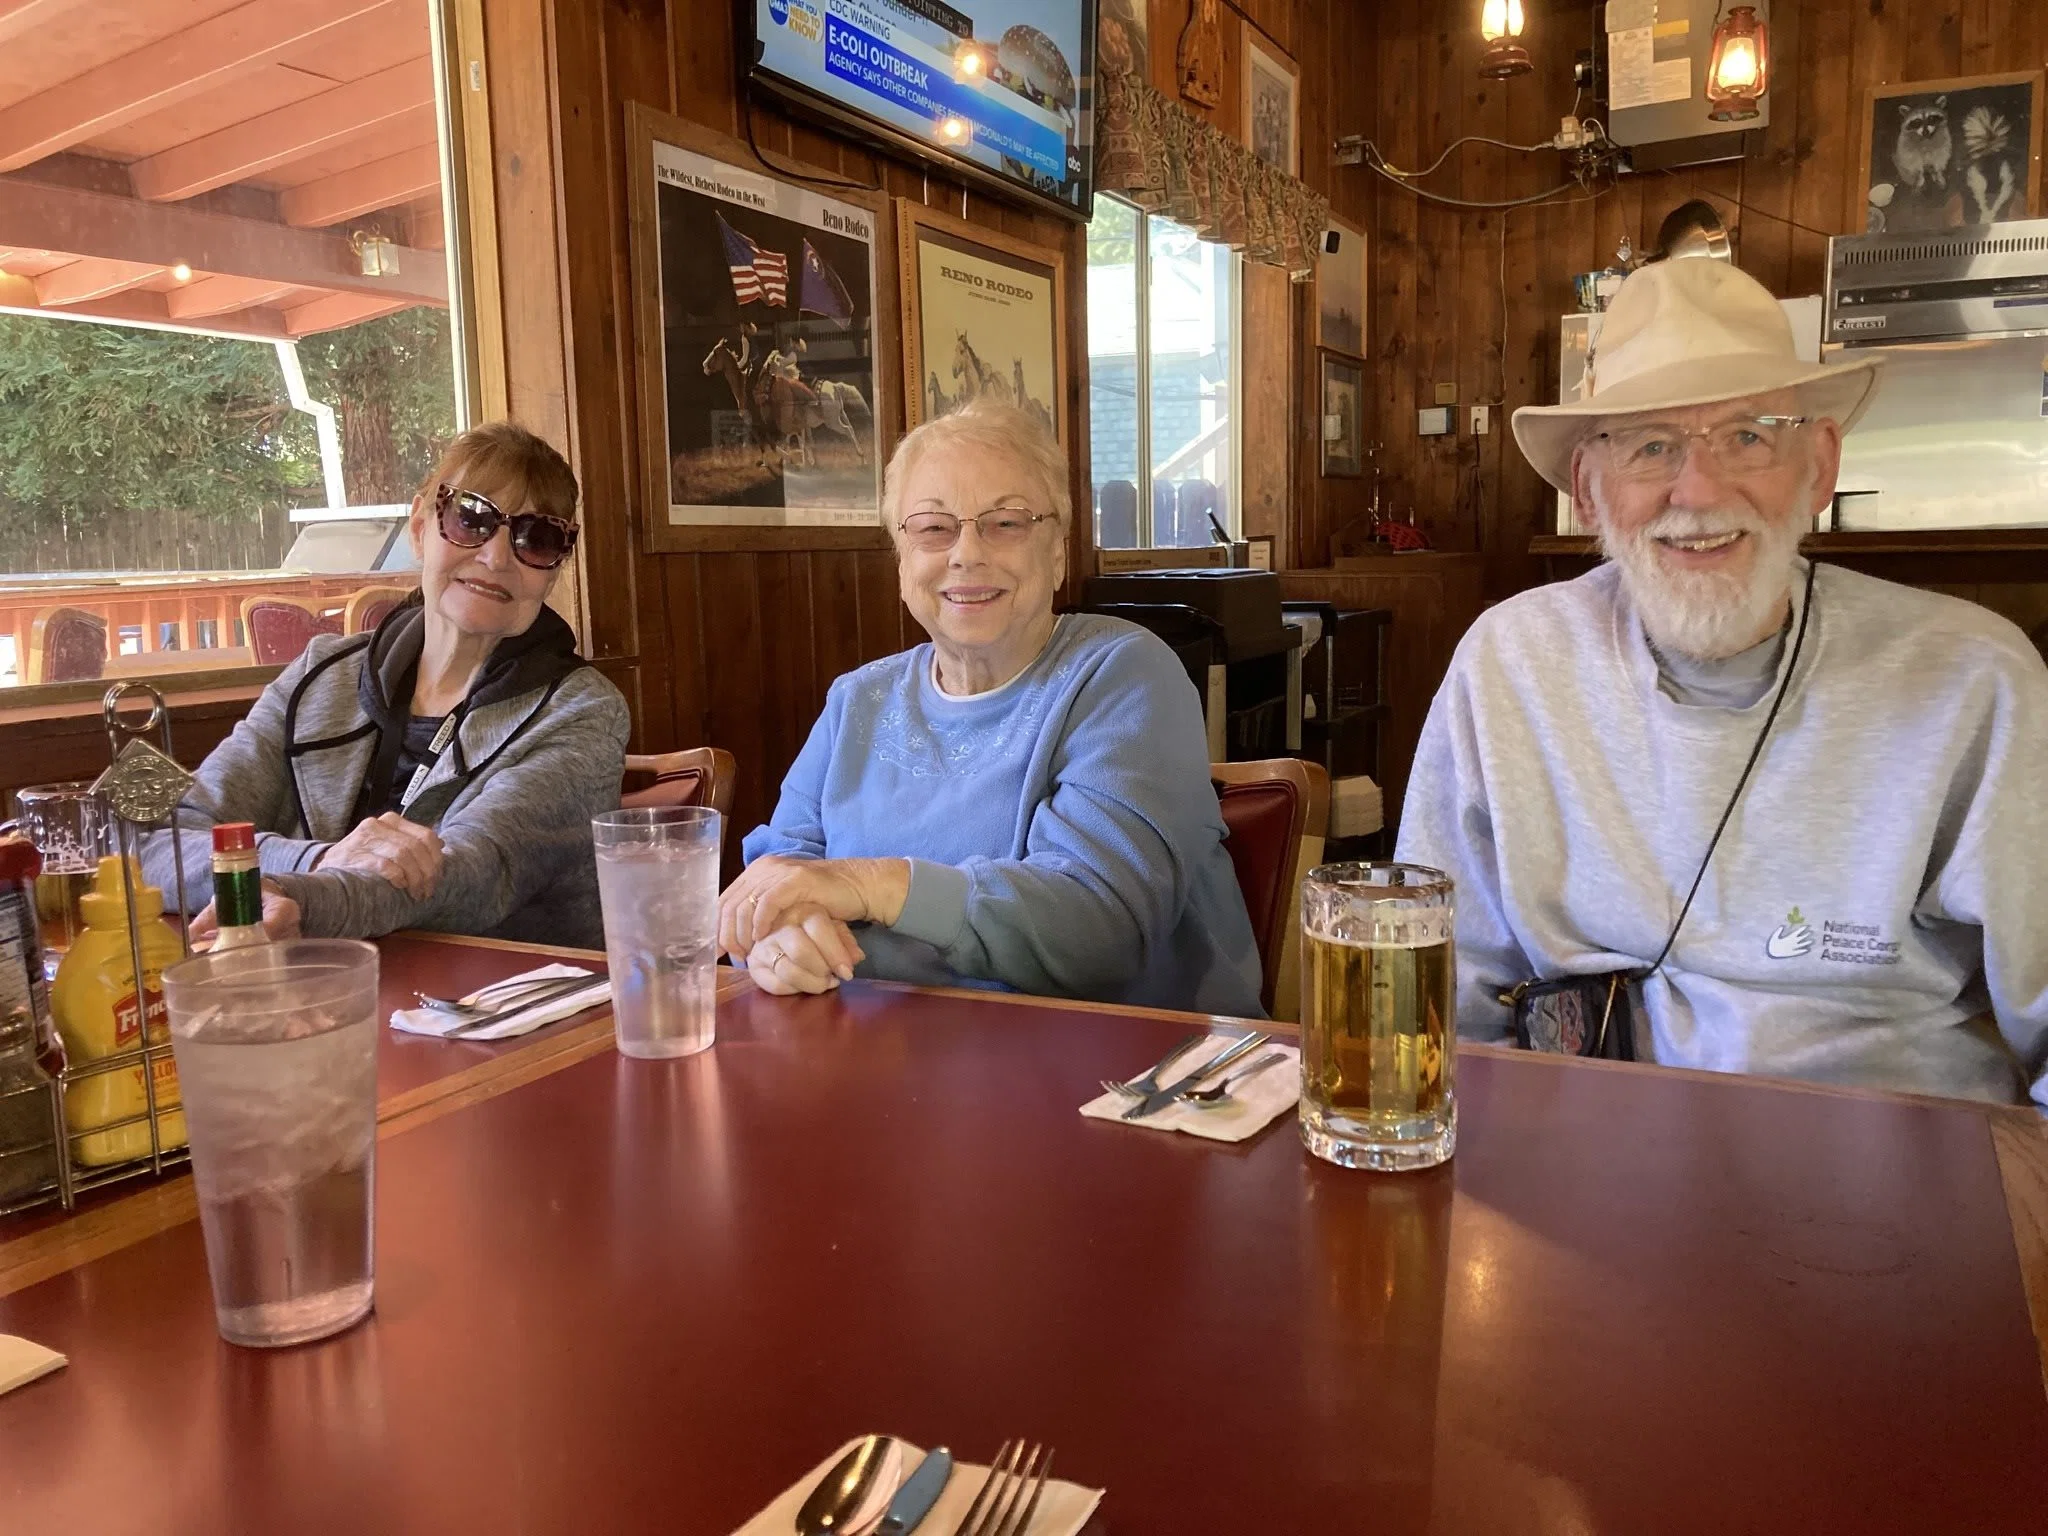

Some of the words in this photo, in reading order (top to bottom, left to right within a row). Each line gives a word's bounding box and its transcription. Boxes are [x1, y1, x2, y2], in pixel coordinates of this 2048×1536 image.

[790, 6, 809, 24] NEED
[811, 16, 821, 29] TO
[806, 5, 817, 16] YOU
[829, 0, 848, 18] CDC
[849, 7, 891, 40] WARNING
[908, 0, 954, 27] OINTING
[788, 17, 817, 41] KNOW
[829, 24, 868, 60] E-COLI
[870, 47, 929, 90] OUTBREAK
[829, 51, 862, 77] AGENCY
[863, 67, 881, 86] SAYS
[882, 77, 906, 99] OTHER
[907, 90, 947, 117] COMPANIES
[1067, 156, 1081, 173] abc
[658, 165, 669, 178] The
[695, 175, 716, 193] Richest
[717, 183, 735, 198] Rodeo
[736, 188, 742, 200] in
[743, 190, 752, 202] the
[753, 194, 766, 207] West
[823, 209, 843, 230] Reno
[845, 216, 869, 238] Rodeo
[941, 266, 983, 287] RENO
[986, 279, 1034, 300] RODEO
[1823, 920, 1881, 936] National
[1822, 934, 1866, 949] Peace
[1867, 937, 1900, 952] Corp
